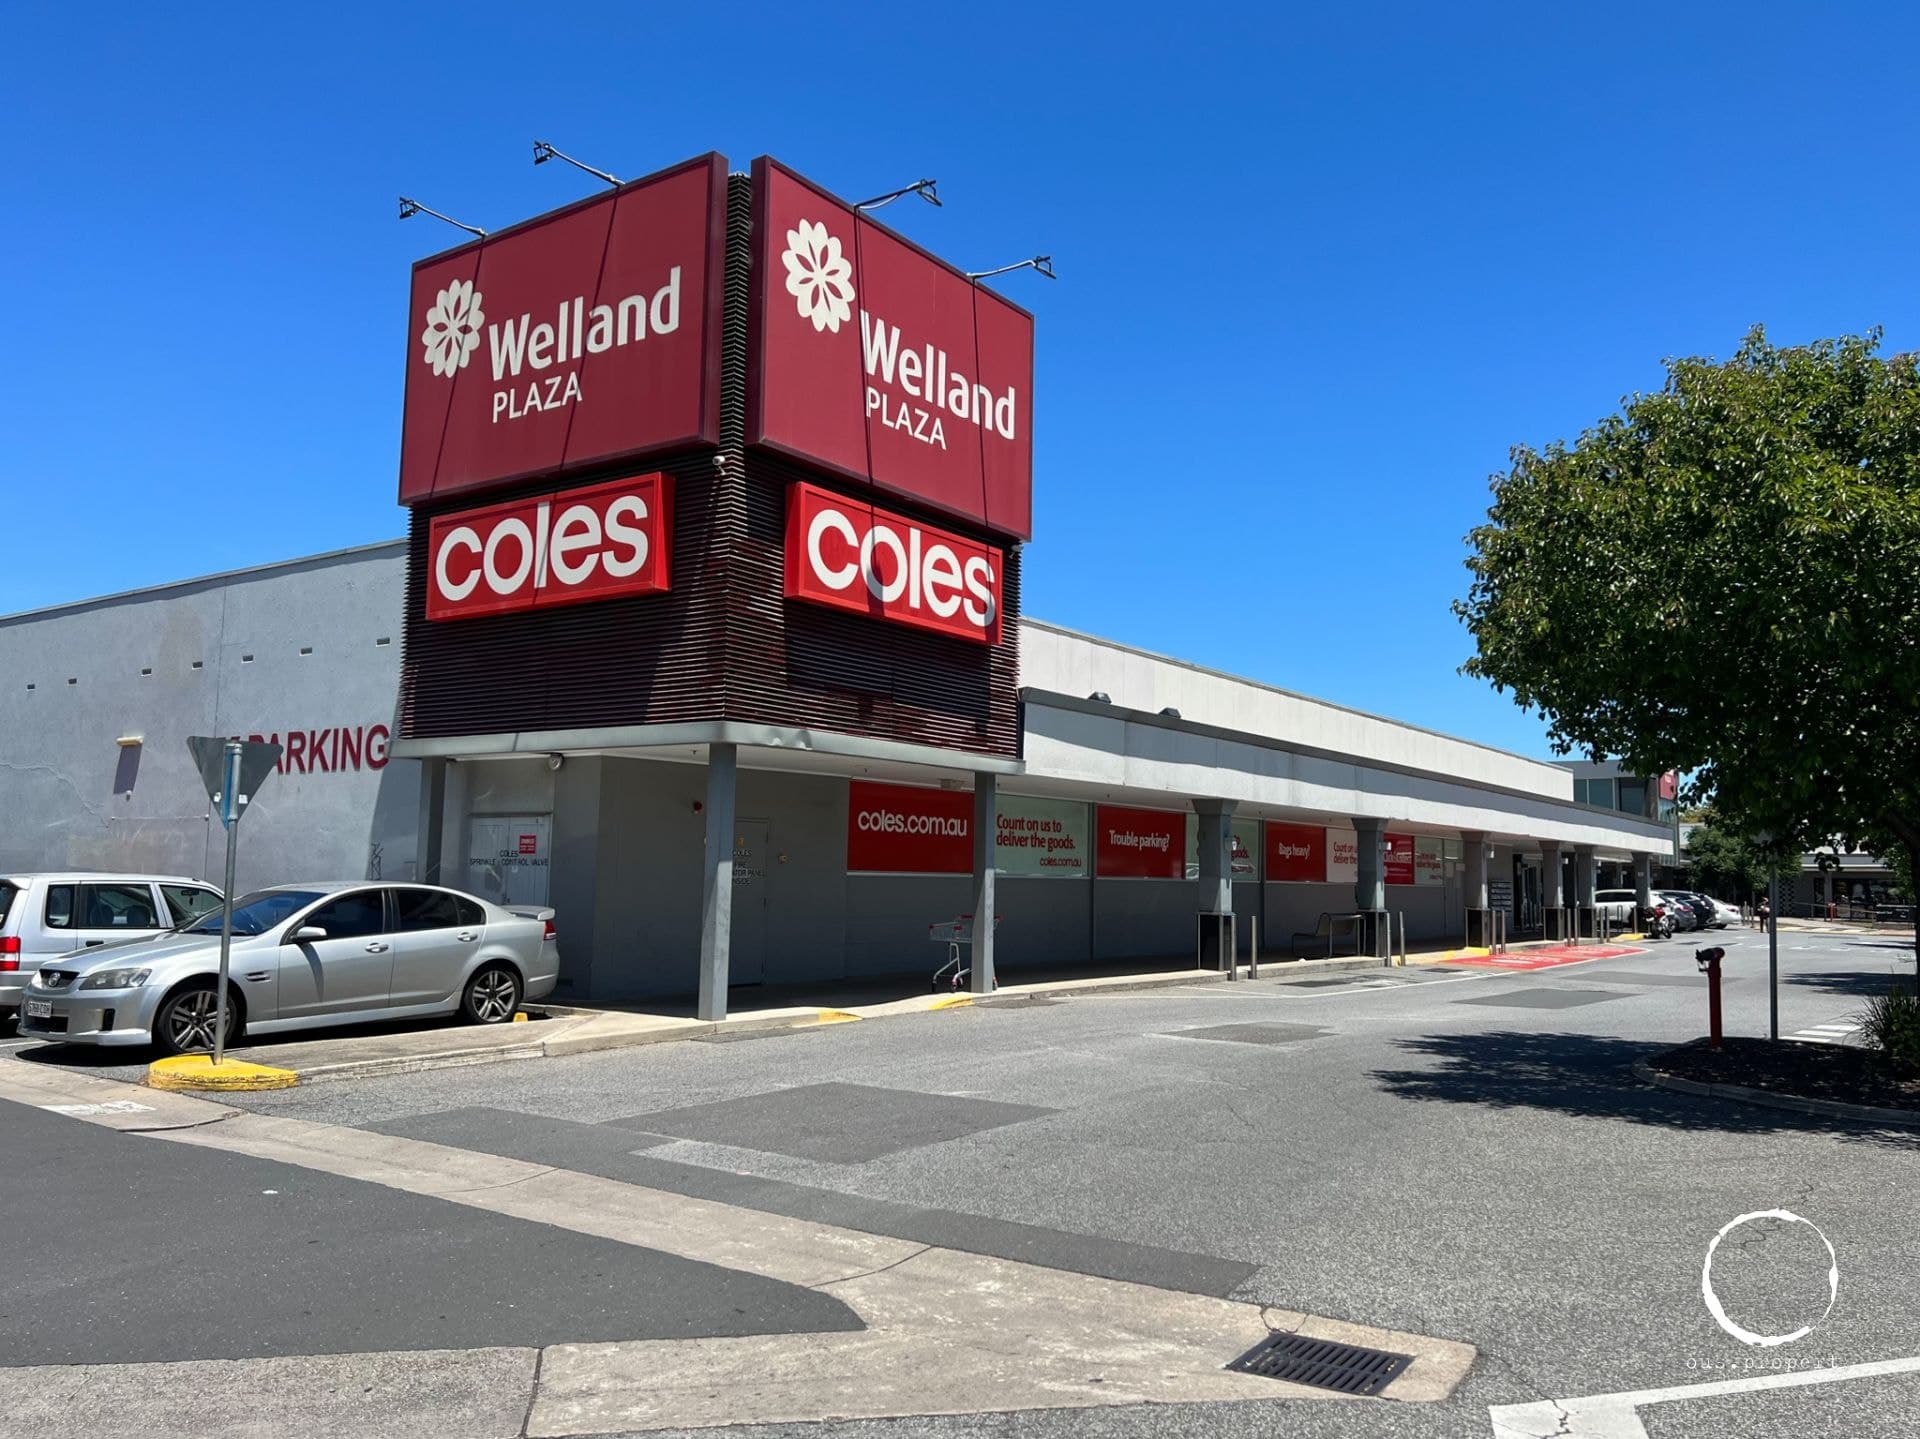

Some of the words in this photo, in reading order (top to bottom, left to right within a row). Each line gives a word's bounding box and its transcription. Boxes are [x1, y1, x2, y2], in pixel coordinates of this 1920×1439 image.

[488, 266, 681, 381] Welland
[492, 371, 583, 423] PLAZA
[860, 309, 1017, 440] Welland
[866, 386, 948, 451] PLAZA
[435, 496, 650, 601] coles
[807, 509, 996, 627] coles
[248, 723, 390, 775] RKING
[857, 809, 967, 837] coles.com.au
[996, 831, 1029, 847] deliver
[1030, 832, 1046, 848] the
[1047, 834, 1076, 852] goods.
[997, 814, 1024, 831] Count
[1026, 819, 1039, 832] on
[1040, 820, 1051, 832] us
[1053, 818, 1062, 833] to
[1109, 829, 1139, 847] Trouble
[1139, 832, 1170, 852] parking?
